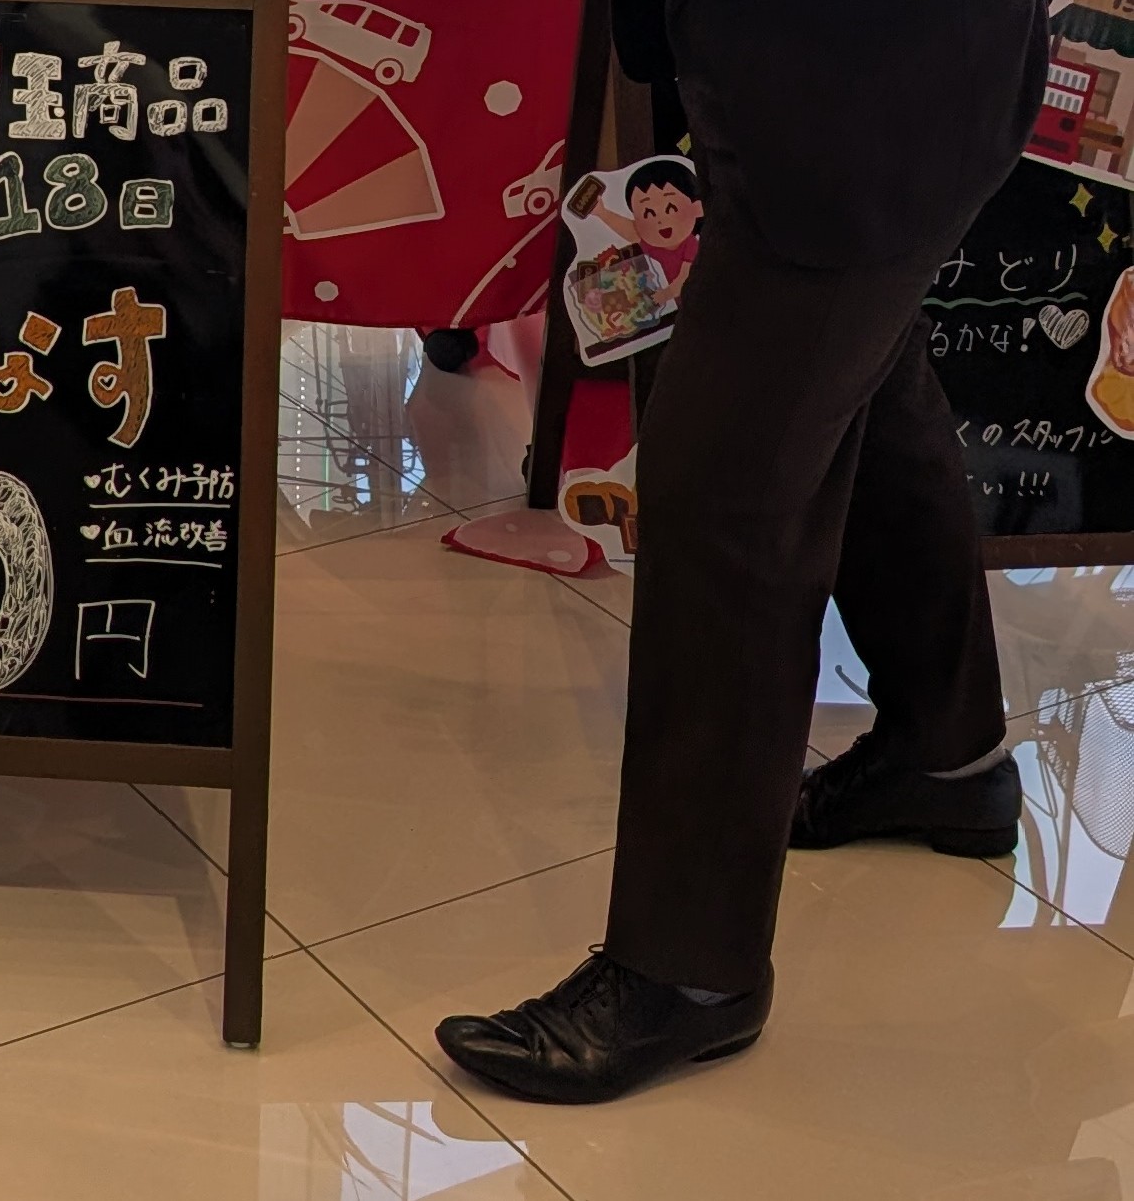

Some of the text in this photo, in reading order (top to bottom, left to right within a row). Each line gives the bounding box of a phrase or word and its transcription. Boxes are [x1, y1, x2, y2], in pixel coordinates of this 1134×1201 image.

[101, 463, 235, 501] むくみ予防
[102, 519, 228, 553] 血流改善
